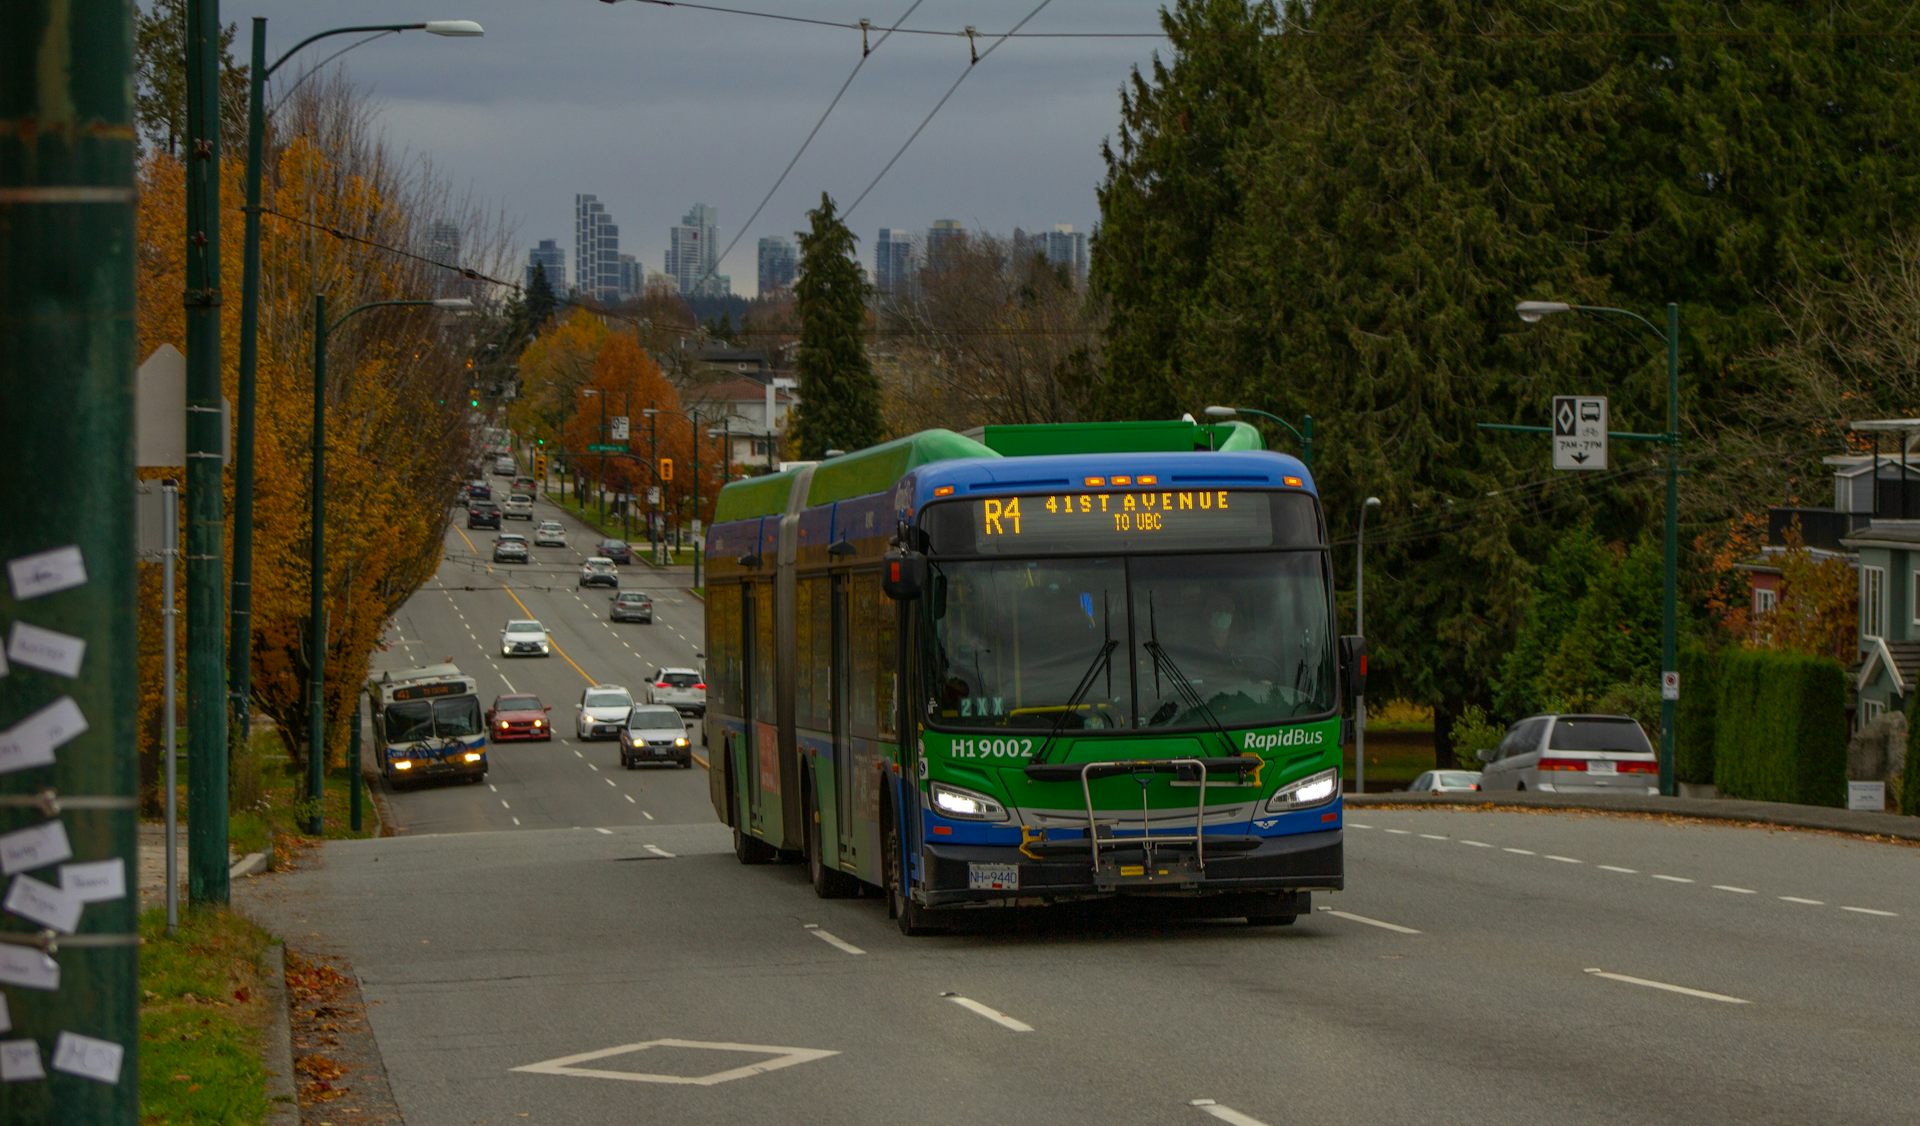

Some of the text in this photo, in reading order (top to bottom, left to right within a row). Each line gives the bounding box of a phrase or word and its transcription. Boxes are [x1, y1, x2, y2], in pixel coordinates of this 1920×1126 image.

[1559, 440, 1577, 450] 7AM
[1584, 440, 1602, 450] 7PM
[1045, 491, 1229, 514] 41ST AVENUE
[984, 496, 1021, 535] R4
[1114, 512, 1162, 531] TO UBC
[951, 739, 1033, 758] H19002
[1243, 728, 1323, 752] RapidBus
